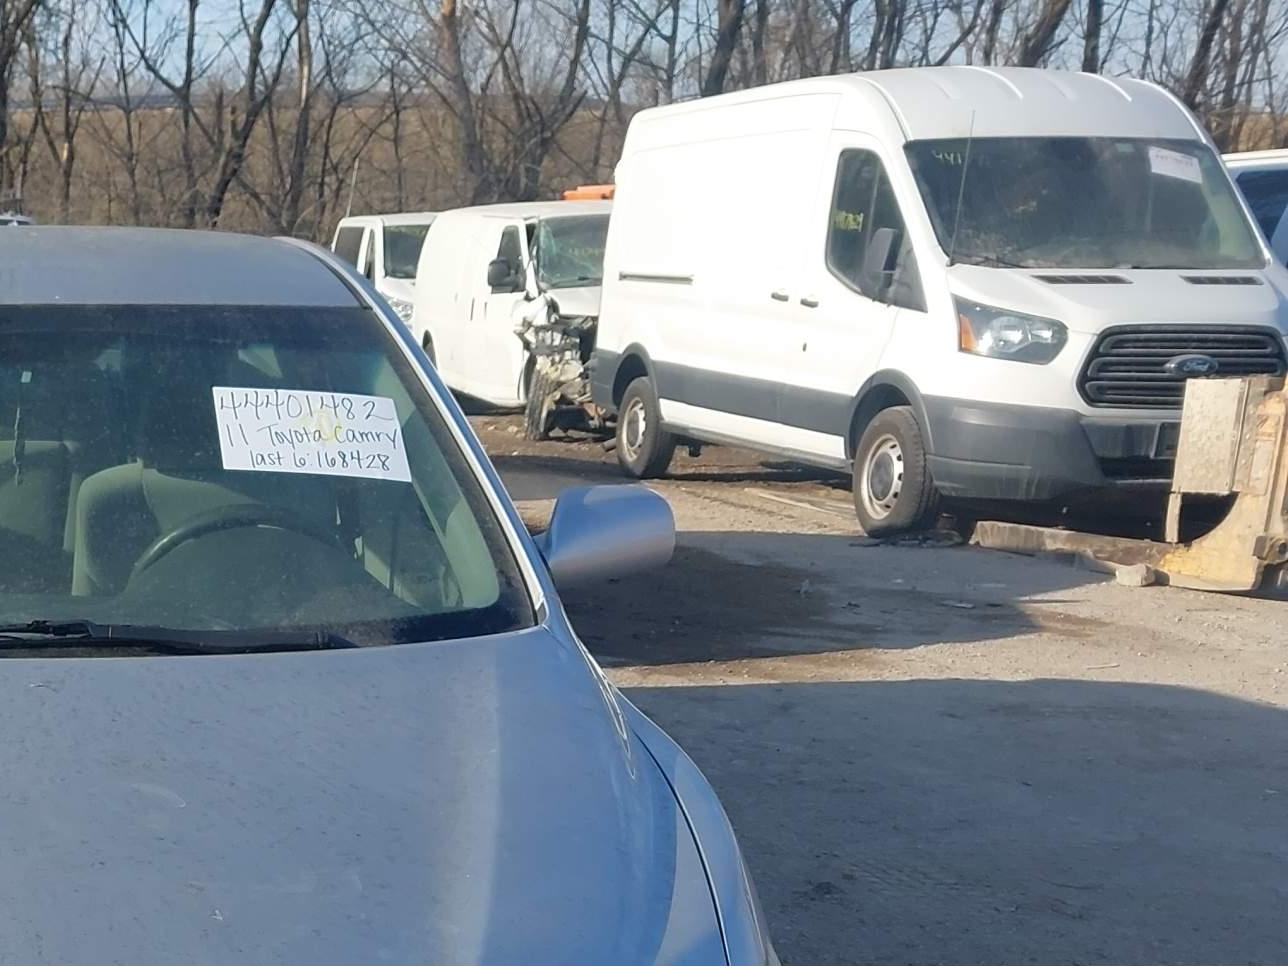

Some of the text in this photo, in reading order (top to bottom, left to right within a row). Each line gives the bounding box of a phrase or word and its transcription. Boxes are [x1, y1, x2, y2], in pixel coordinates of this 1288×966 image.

[1183, 360, 1210, 371] Ford
[220, 390, 394, 421] 44401482
[226, 423, 249, 447] 11
[257, 423, 328, 449] Toyota
[250, 449, 284, 469] last
